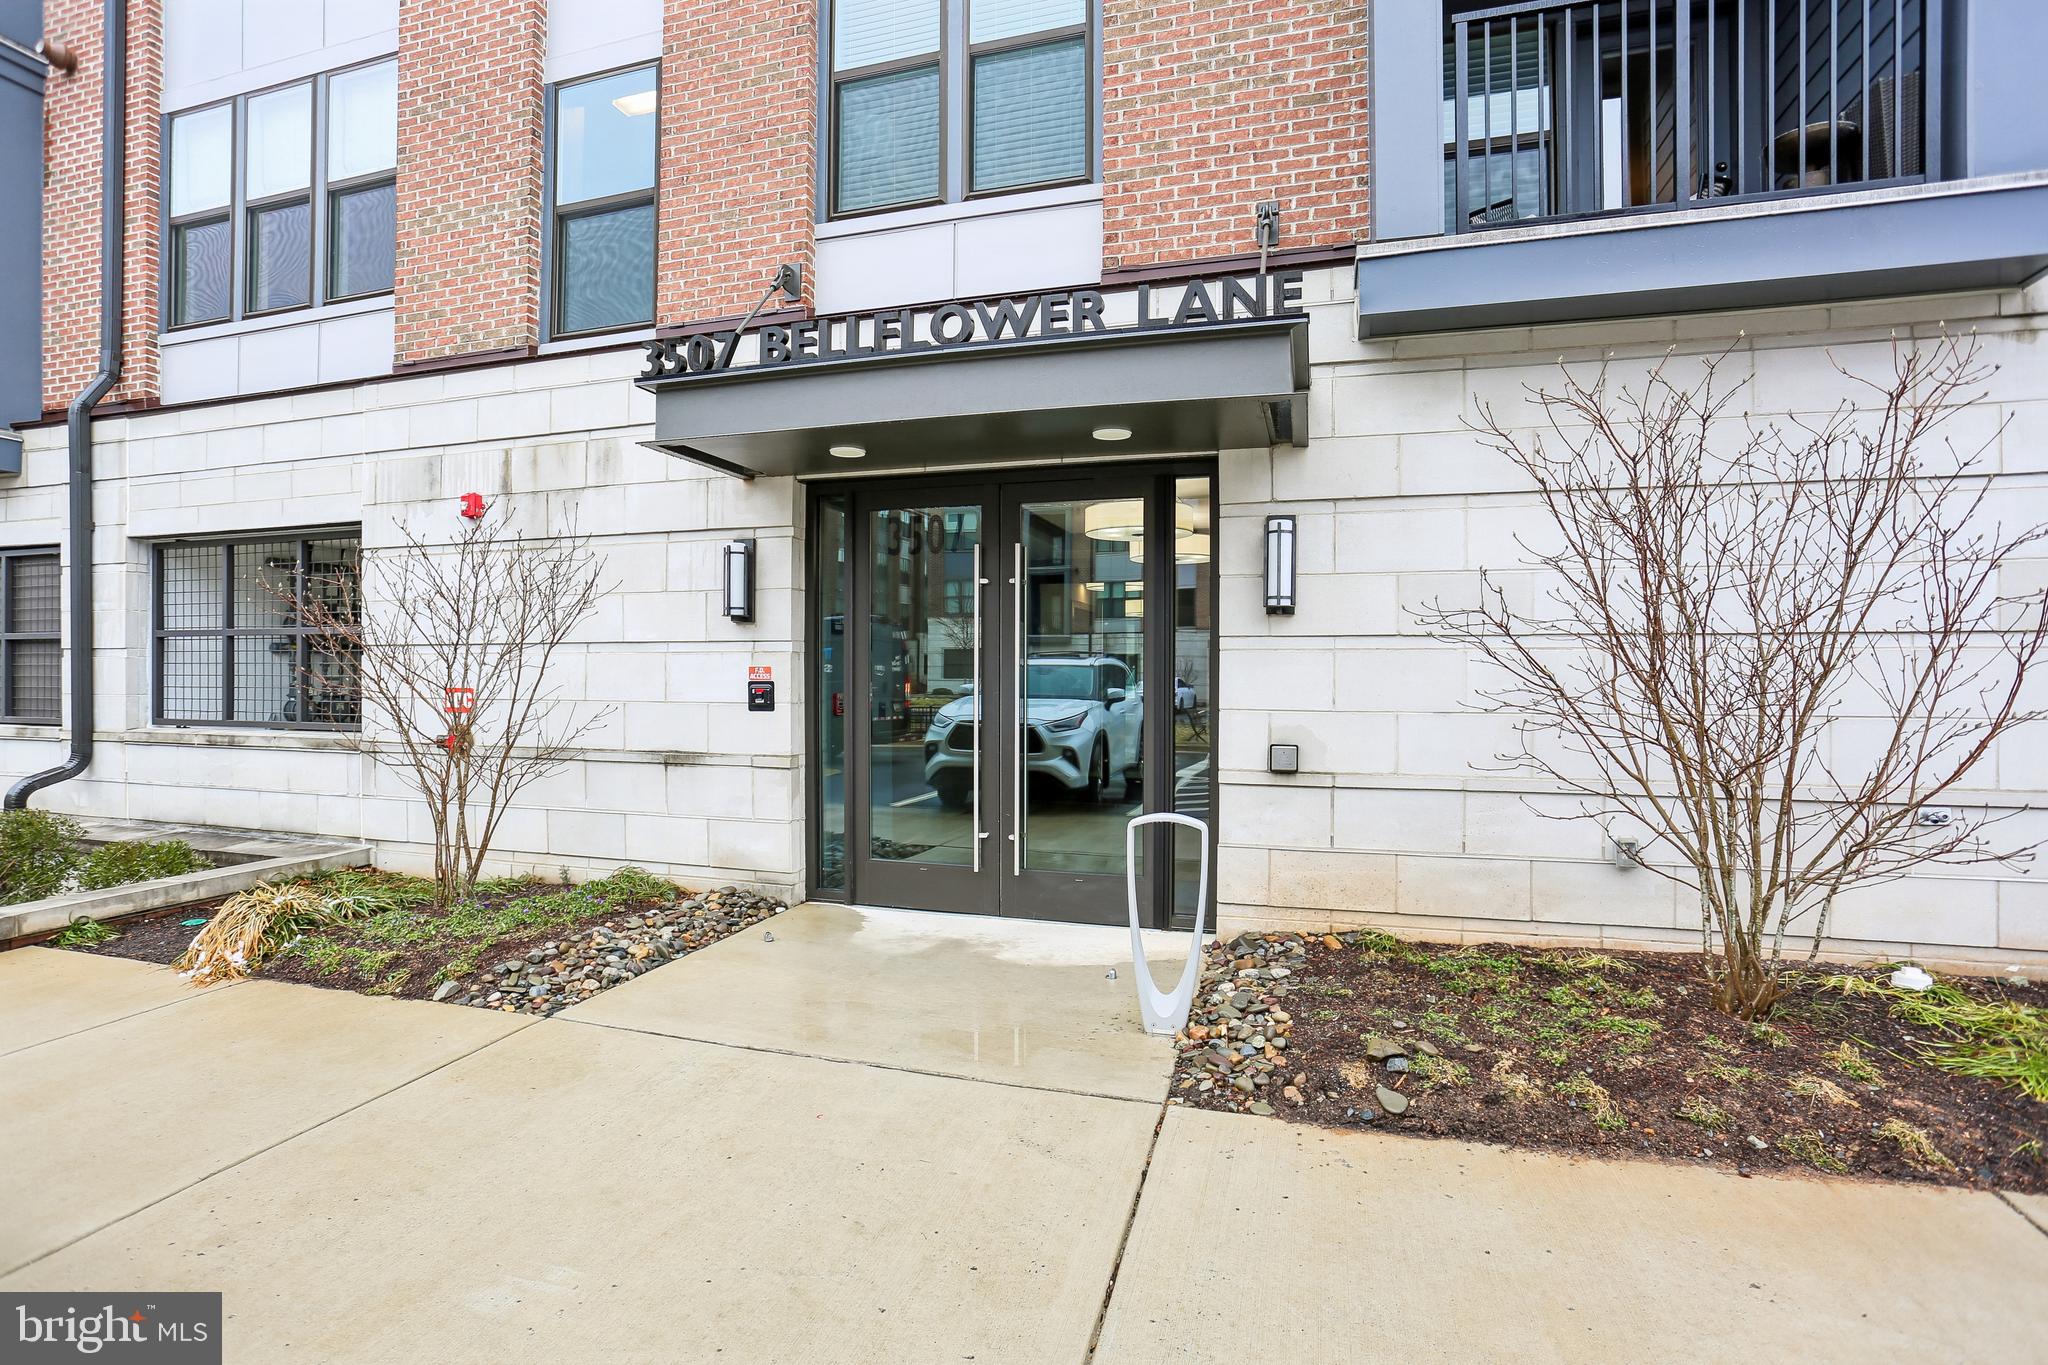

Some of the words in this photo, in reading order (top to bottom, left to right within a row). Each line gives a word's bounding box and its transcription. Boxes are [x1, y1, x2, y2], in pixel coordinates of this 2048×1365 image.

[640, 331, 742, 377] 3507
[760, 290, 1106, 364] BELLFLOWER
[1138, 270, 1304, 327] LANE
